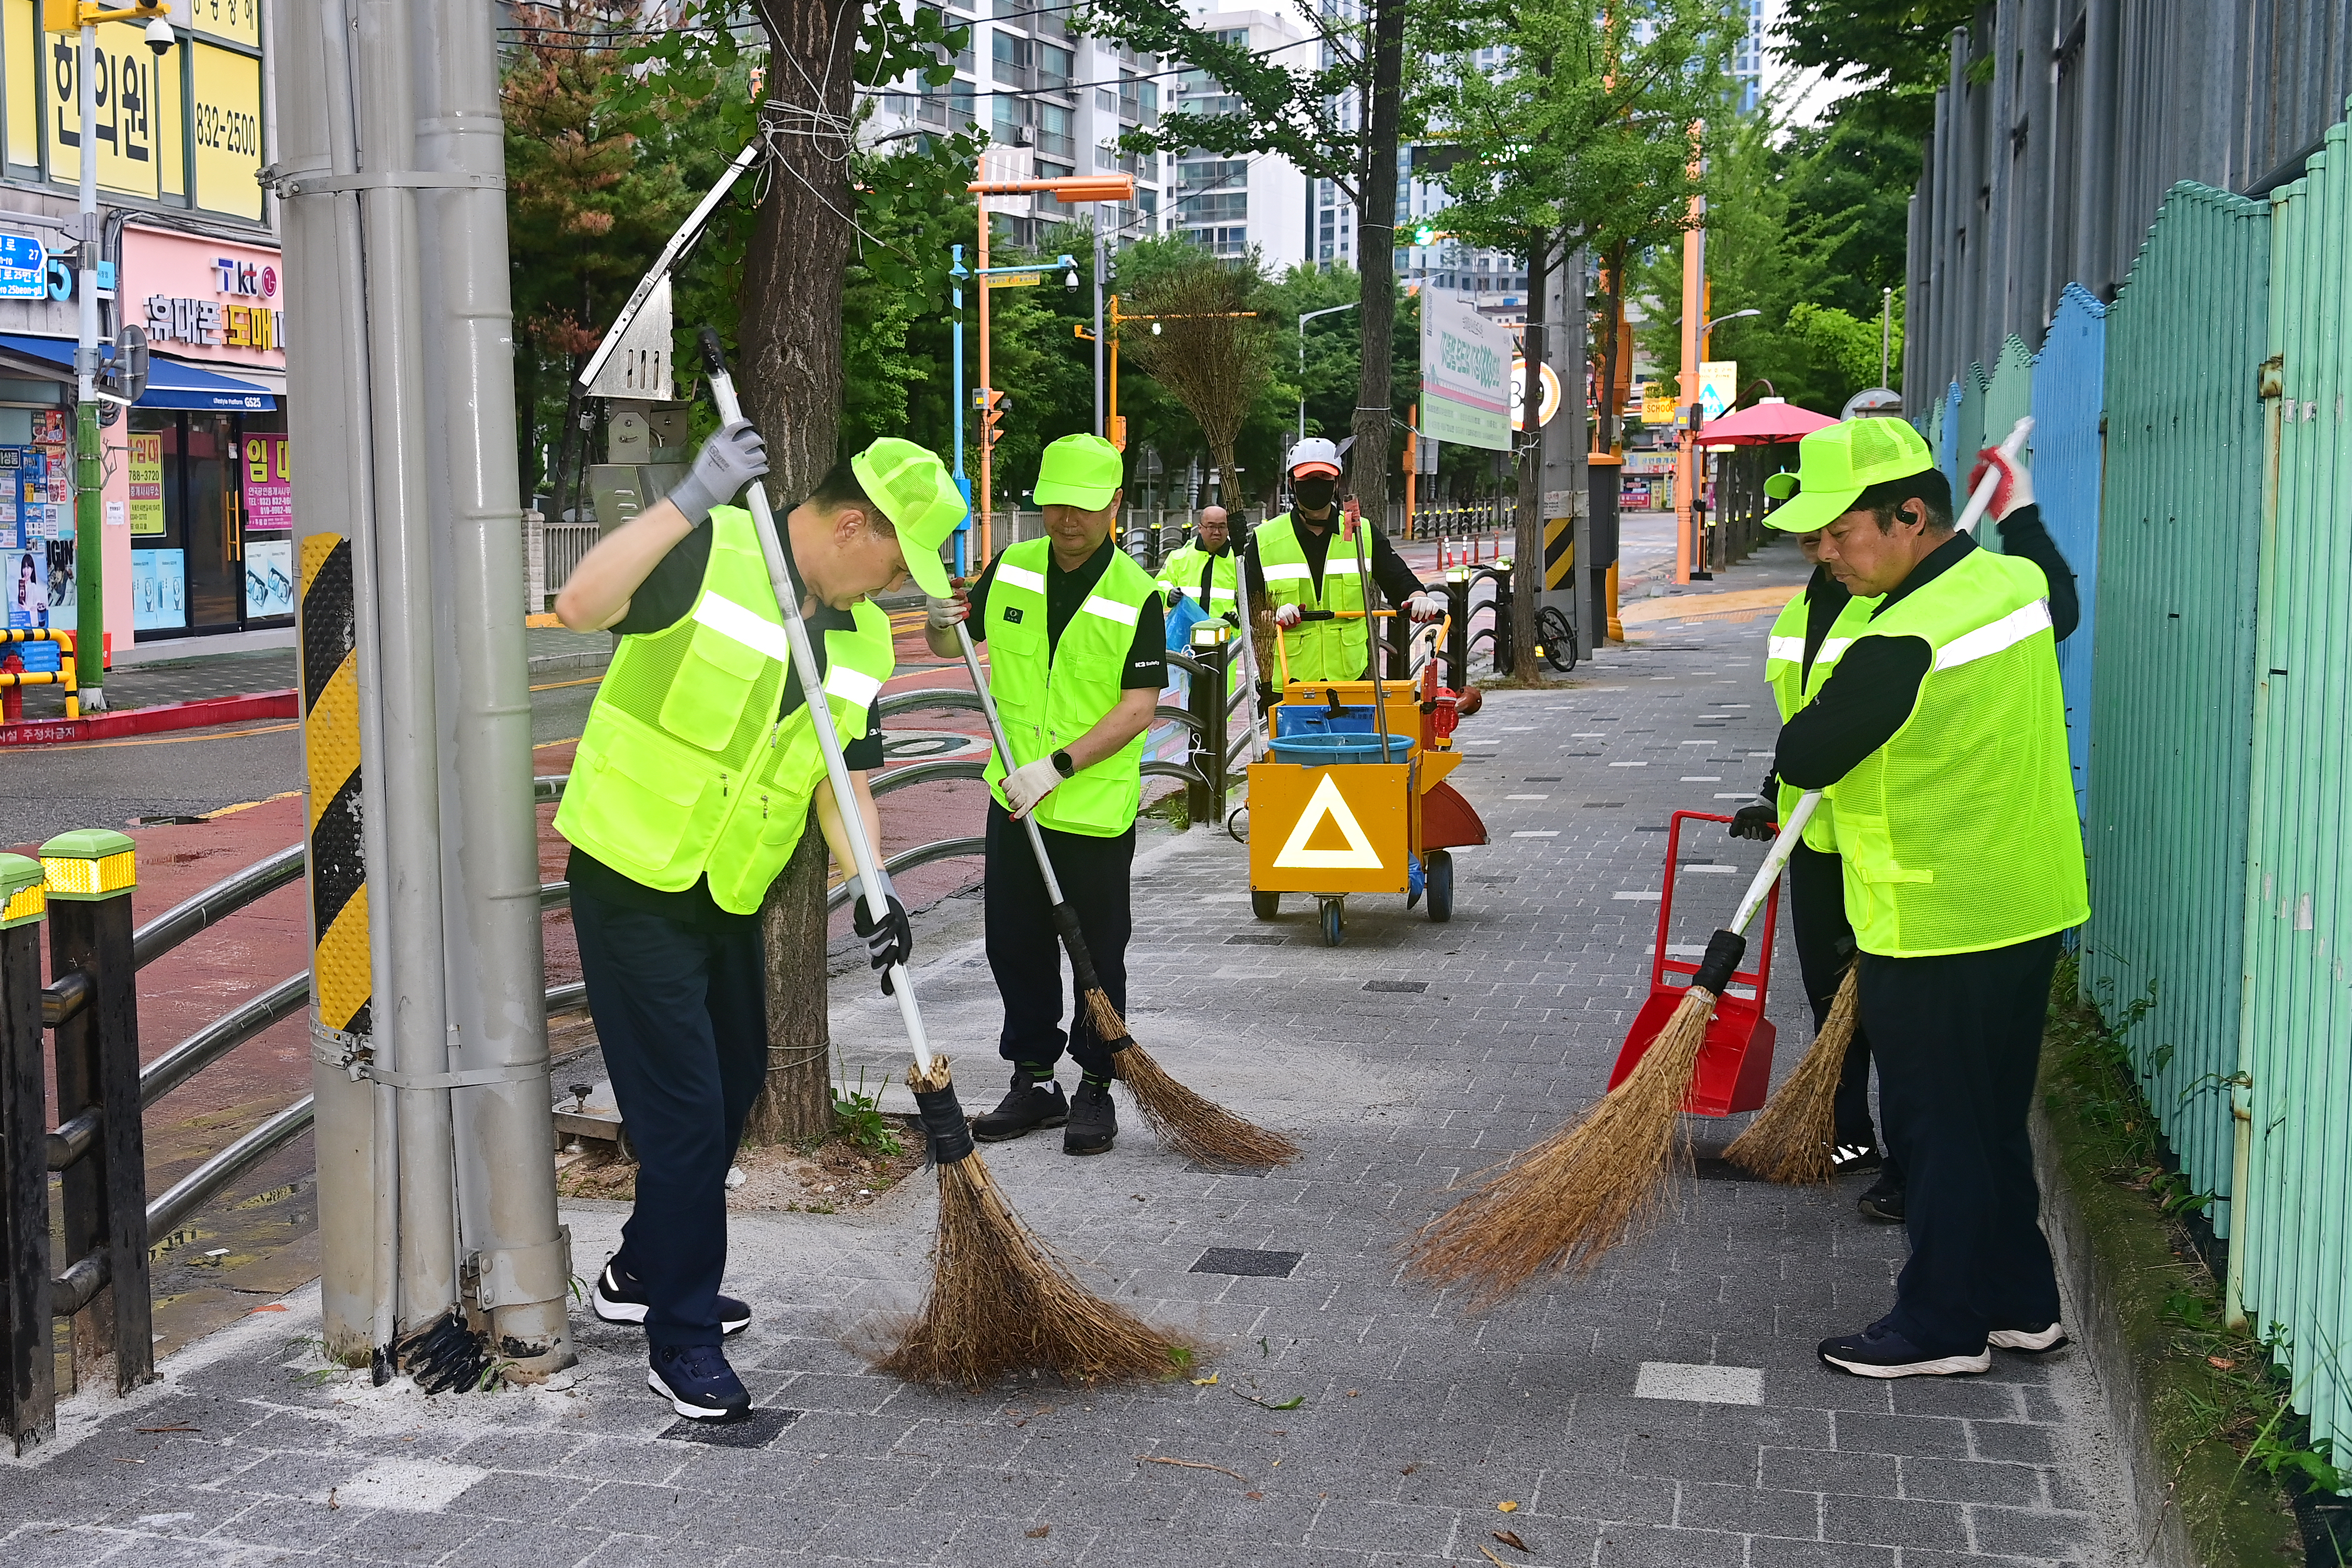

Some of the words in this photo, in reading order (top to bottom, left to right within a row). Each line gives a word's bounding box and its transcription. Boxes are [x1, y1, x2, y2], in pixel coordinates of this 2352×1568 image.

[54, 36, 148, 162] 한의원
[197, 102, 256, 157] 832-2500
[0, 237, 16, 251] 로
[28, 249, 39, 261] 27
[8, 285, 42, 296] 25beon-gil
[144, 293, 221, 345] 휴대폰
[245, 397, 261, 408] GS25
[1646, 404, 1674, 413] SCHOOL
[23, 727, 75, 741] 주정차금지
